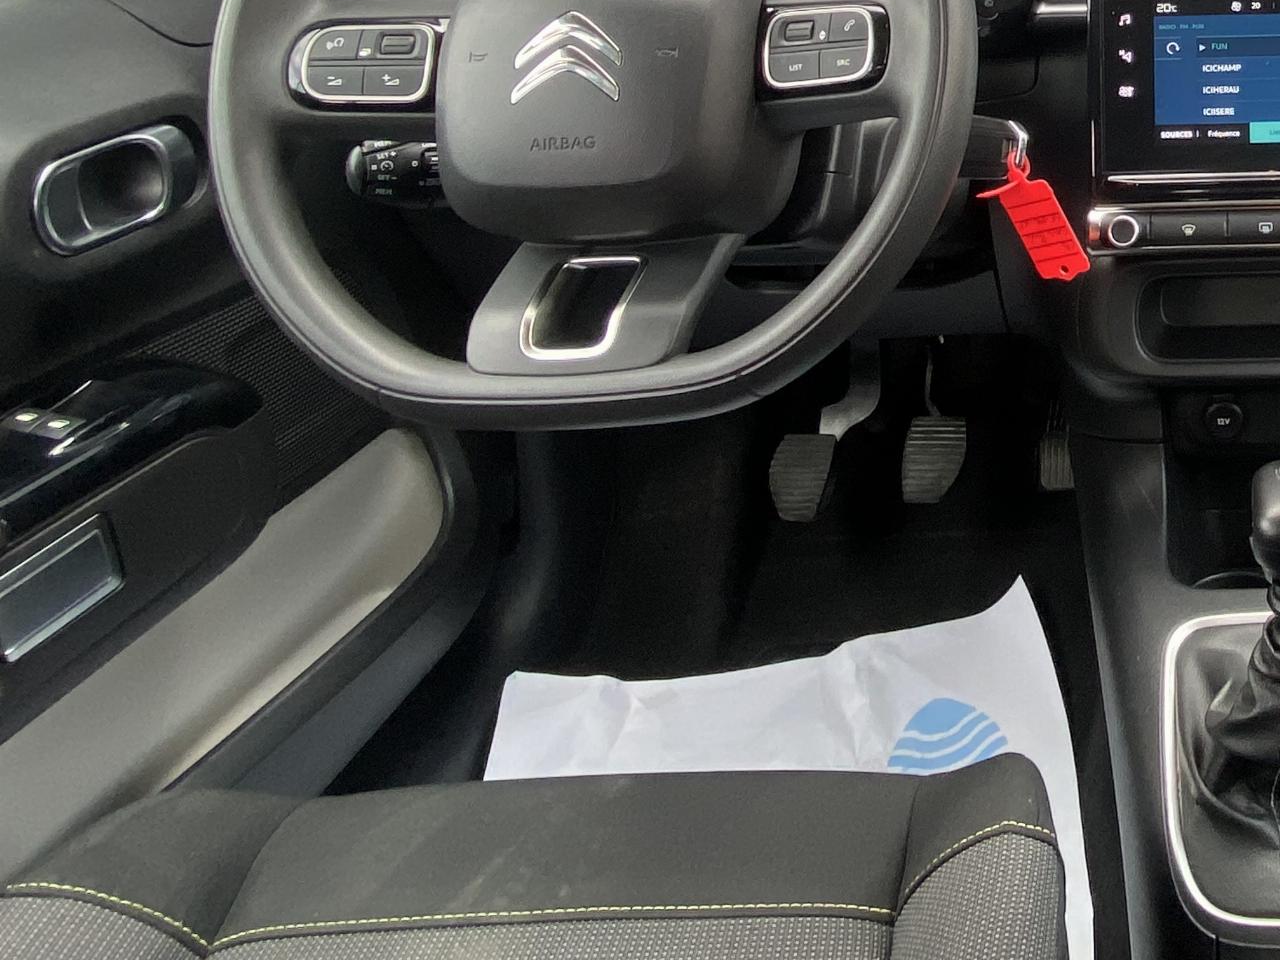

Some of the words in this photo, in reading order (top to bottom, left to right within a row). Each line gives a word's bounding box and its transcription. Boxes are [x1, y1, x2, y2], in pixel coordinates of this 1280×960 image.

[1211, 42, 1228, 51] FUN
[788, 63, 803, 72] LIST
[1160, 130, 1193, 139] SOURCES
[529, 136, 596, 153] AIRBAG
[1217, 417, 1231, 426] 12V
